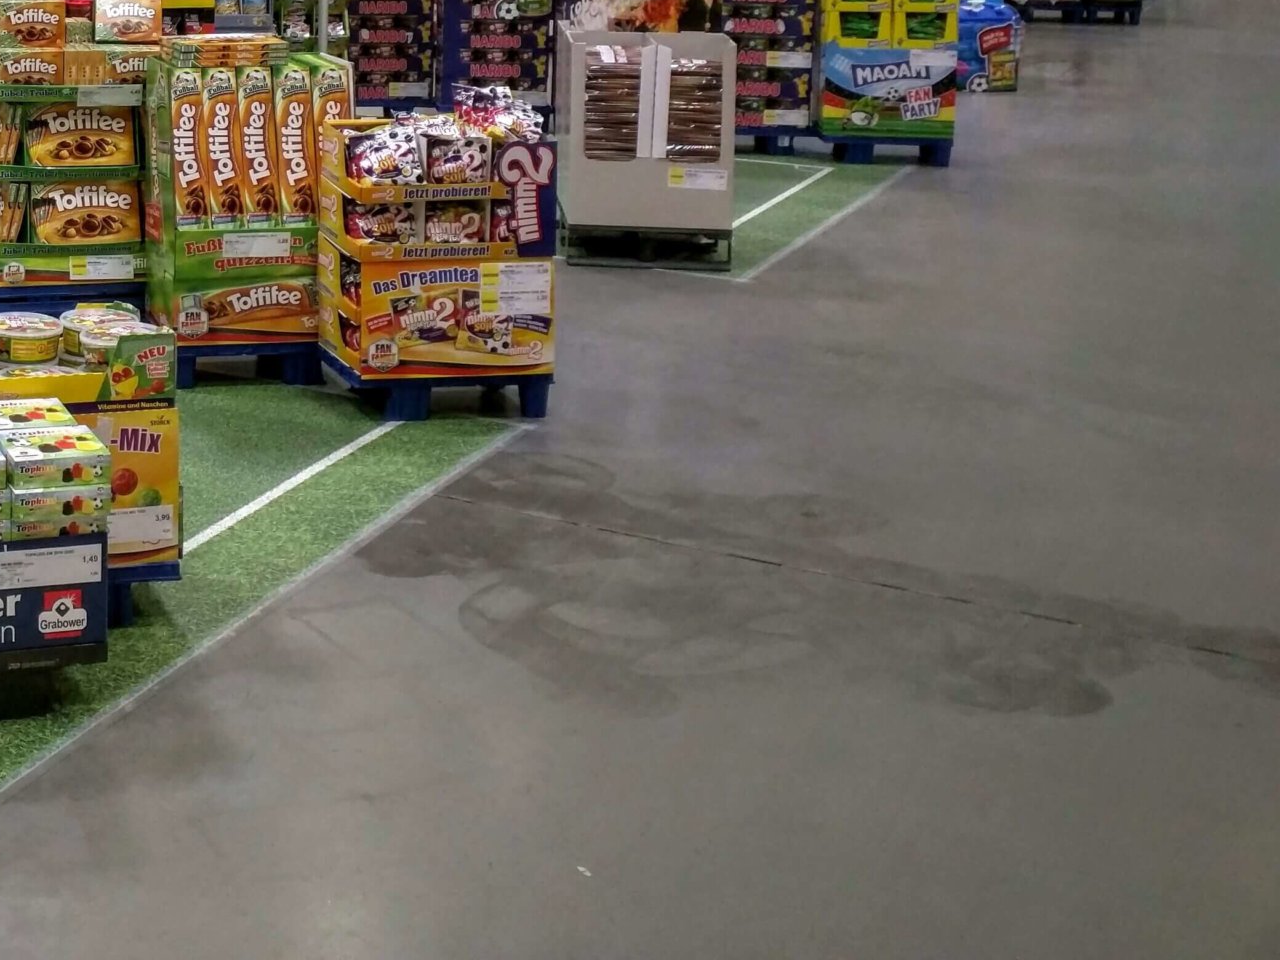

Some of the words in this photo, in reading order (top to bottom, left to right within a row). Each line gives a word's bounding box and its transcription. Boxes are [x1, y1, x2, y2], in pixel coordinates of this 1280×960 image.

[6, 8, 60, 26] Toffifee
[104, 2, 156, 19] Toffifee
[470, 35, 521, 48] HARIBO
[4, 59, 58, 75] Toffifee
[112, 57, 147, 74] Toffi
[470, 63, 521, 77] HARIBO
[856, 64, 928, 86] MAOAM
[173, 85, 199, 96] Fußball
[207, 84, 233, 95] Fußball
[244, 83, 269, 95] Fußball
[281, 83, 308, 95] Fußball
[319, 82, 345, 93] Fußball
[357, 86, 388, 99] HARI
[737, 82, 781, 97] ARIBO
[906, 86, 933, 103] FAN
[901, 98, 940, 120] PARTY
[40, 108, 126, 135] Toffifee
[48, 185, 133, 212] Toffifee
[403, 188, 430, 200] Jetzt
[432, 185, 491, 200] probieren!
[402, 246, 428, 259] Jetzt
[431, 244, 490, 259] probieren!
[372, 279, 398, 295] Das
[399, 267, 480, 289] Dreamtea
[226, 285, 302, 313] Toffifee
[136, 345, 167, 364] NEU
[375, 343, 392, 354] FAN
[127, 402, 140, 410] und
[82, 555, 99, 564] 1,49
[40, 616, 85, 630] Grabower
